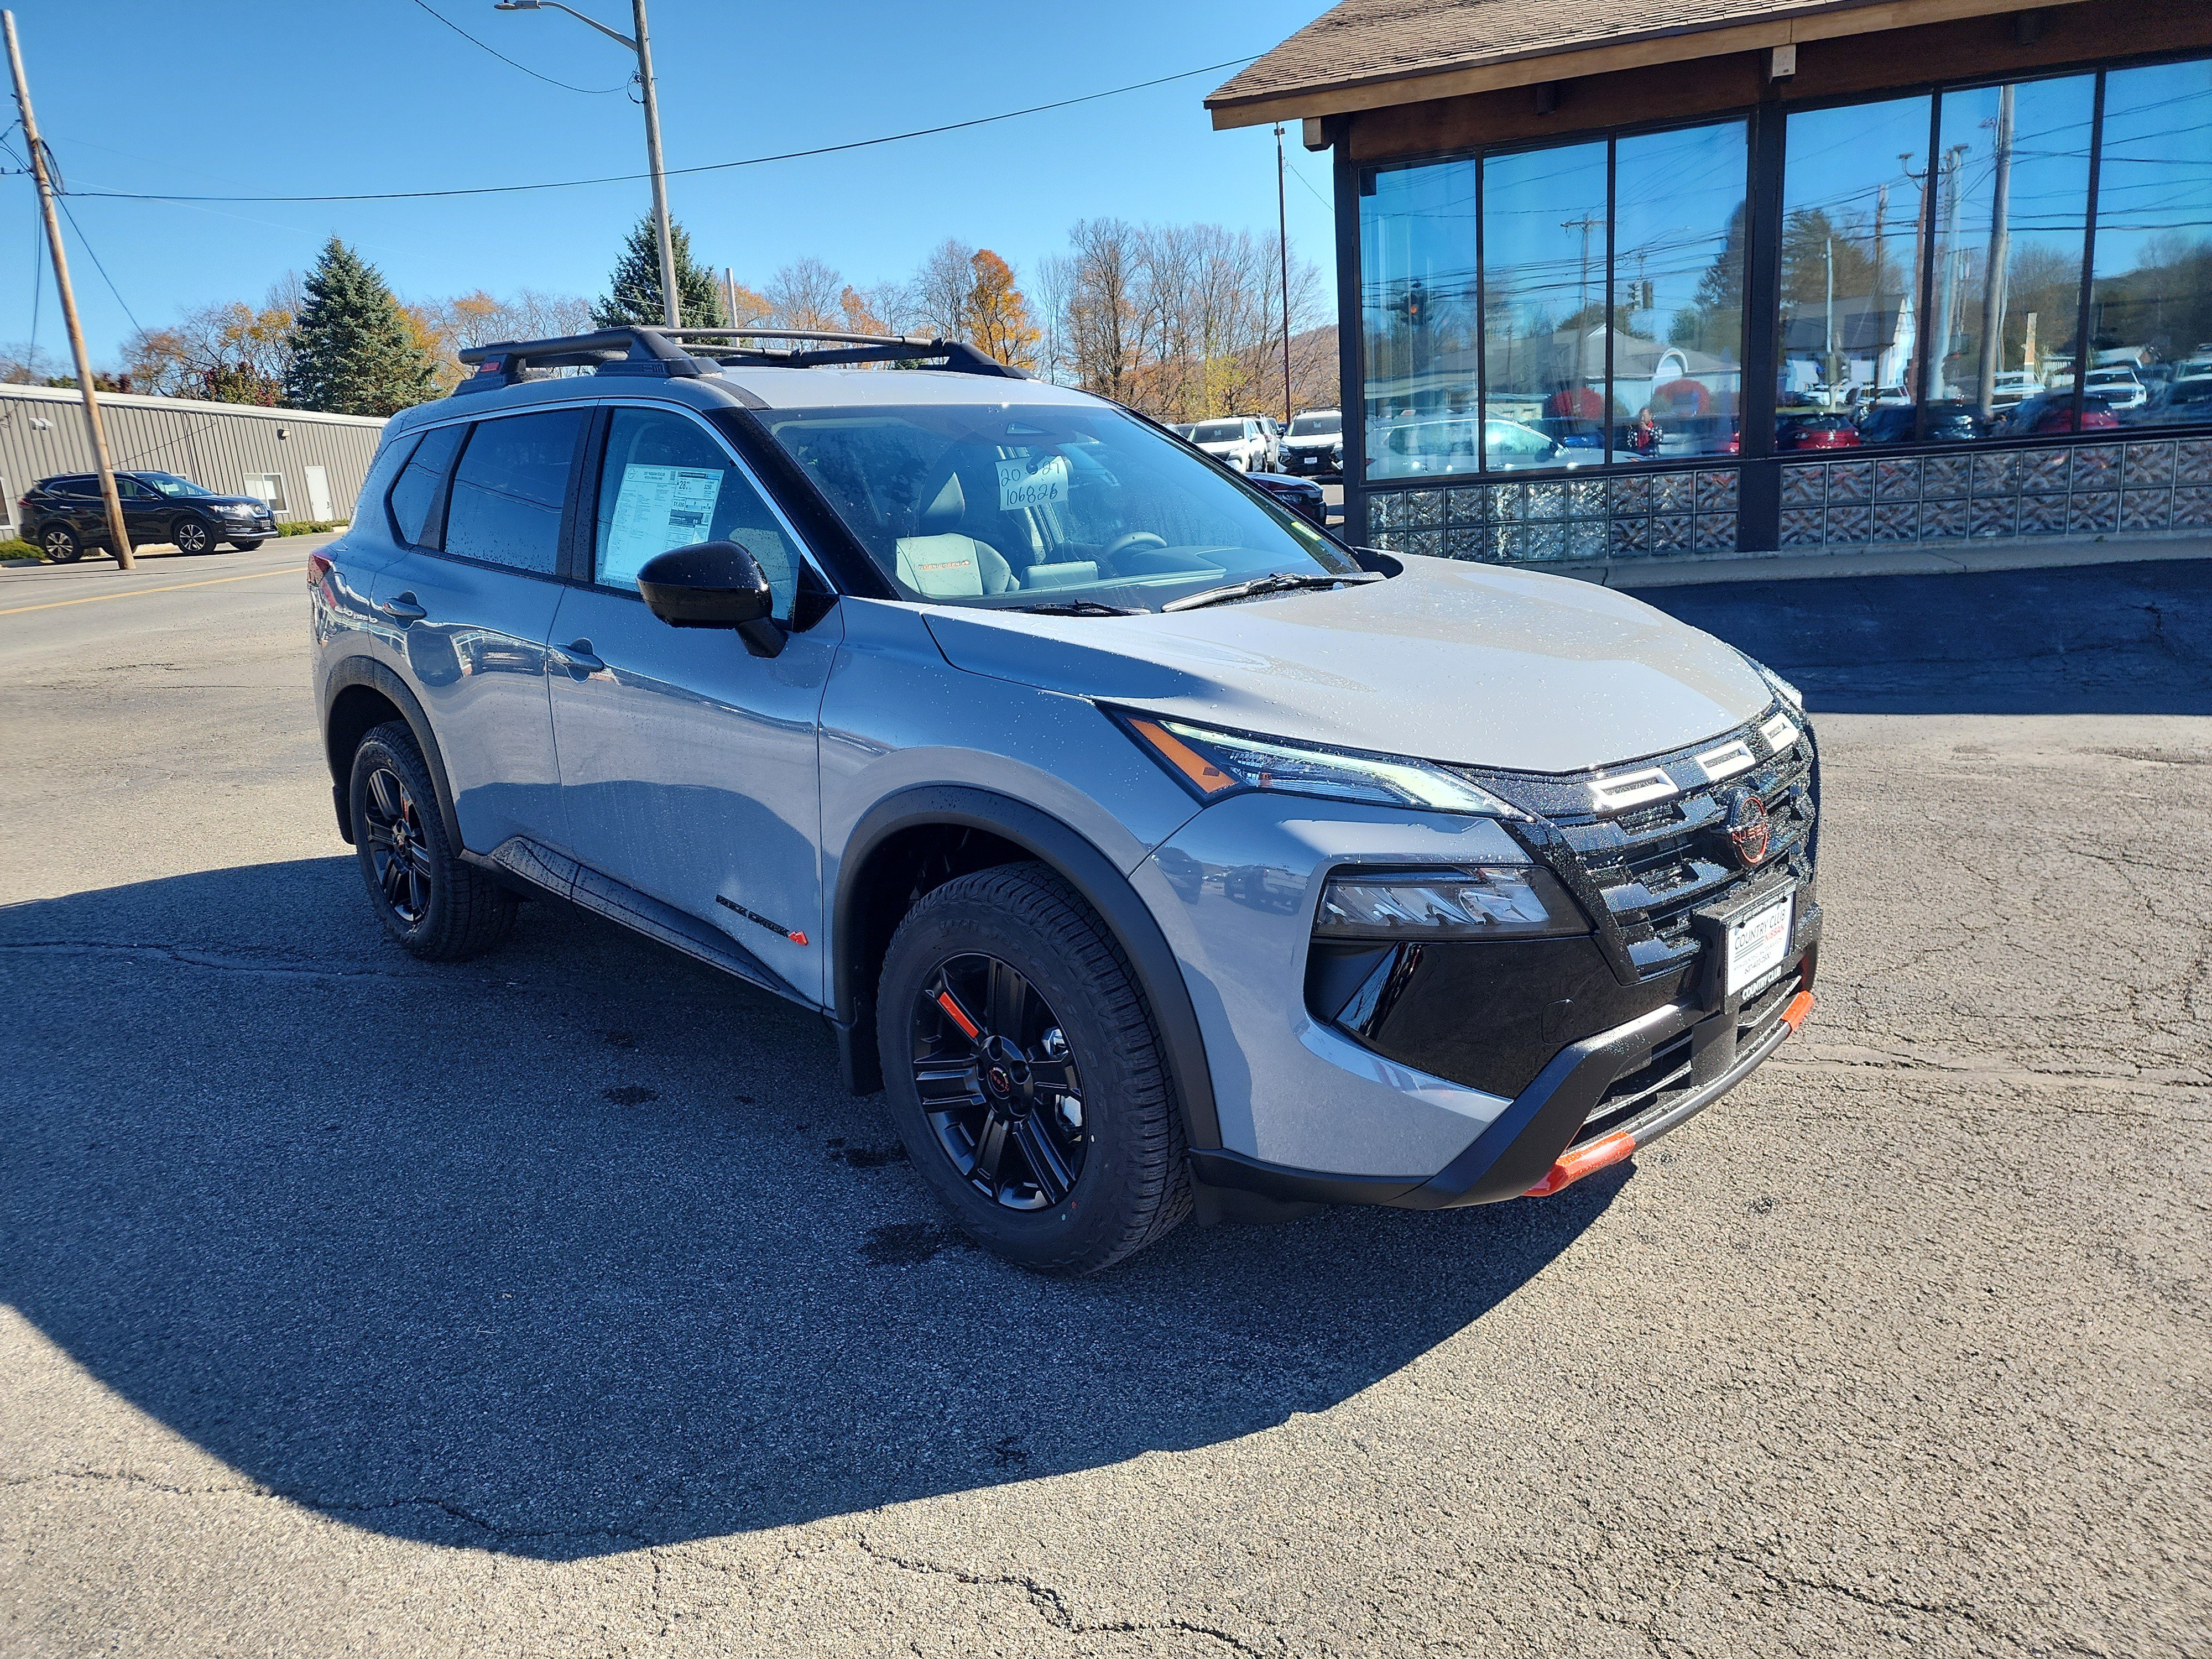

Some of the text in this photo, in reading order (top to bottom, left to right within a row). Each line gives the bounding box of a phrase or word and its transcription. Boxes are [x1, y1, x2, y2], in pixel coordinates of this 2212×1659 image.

[679, 480, 686, 490] 28
[1001, 468, 1021, 487] 20
[1735, 909, 1786, 950] COUNTRY CLUB
[1765, 924, 1785, 942] NISSAN
[1742, 965, 1782, 1001] COUNTRY CLUB
